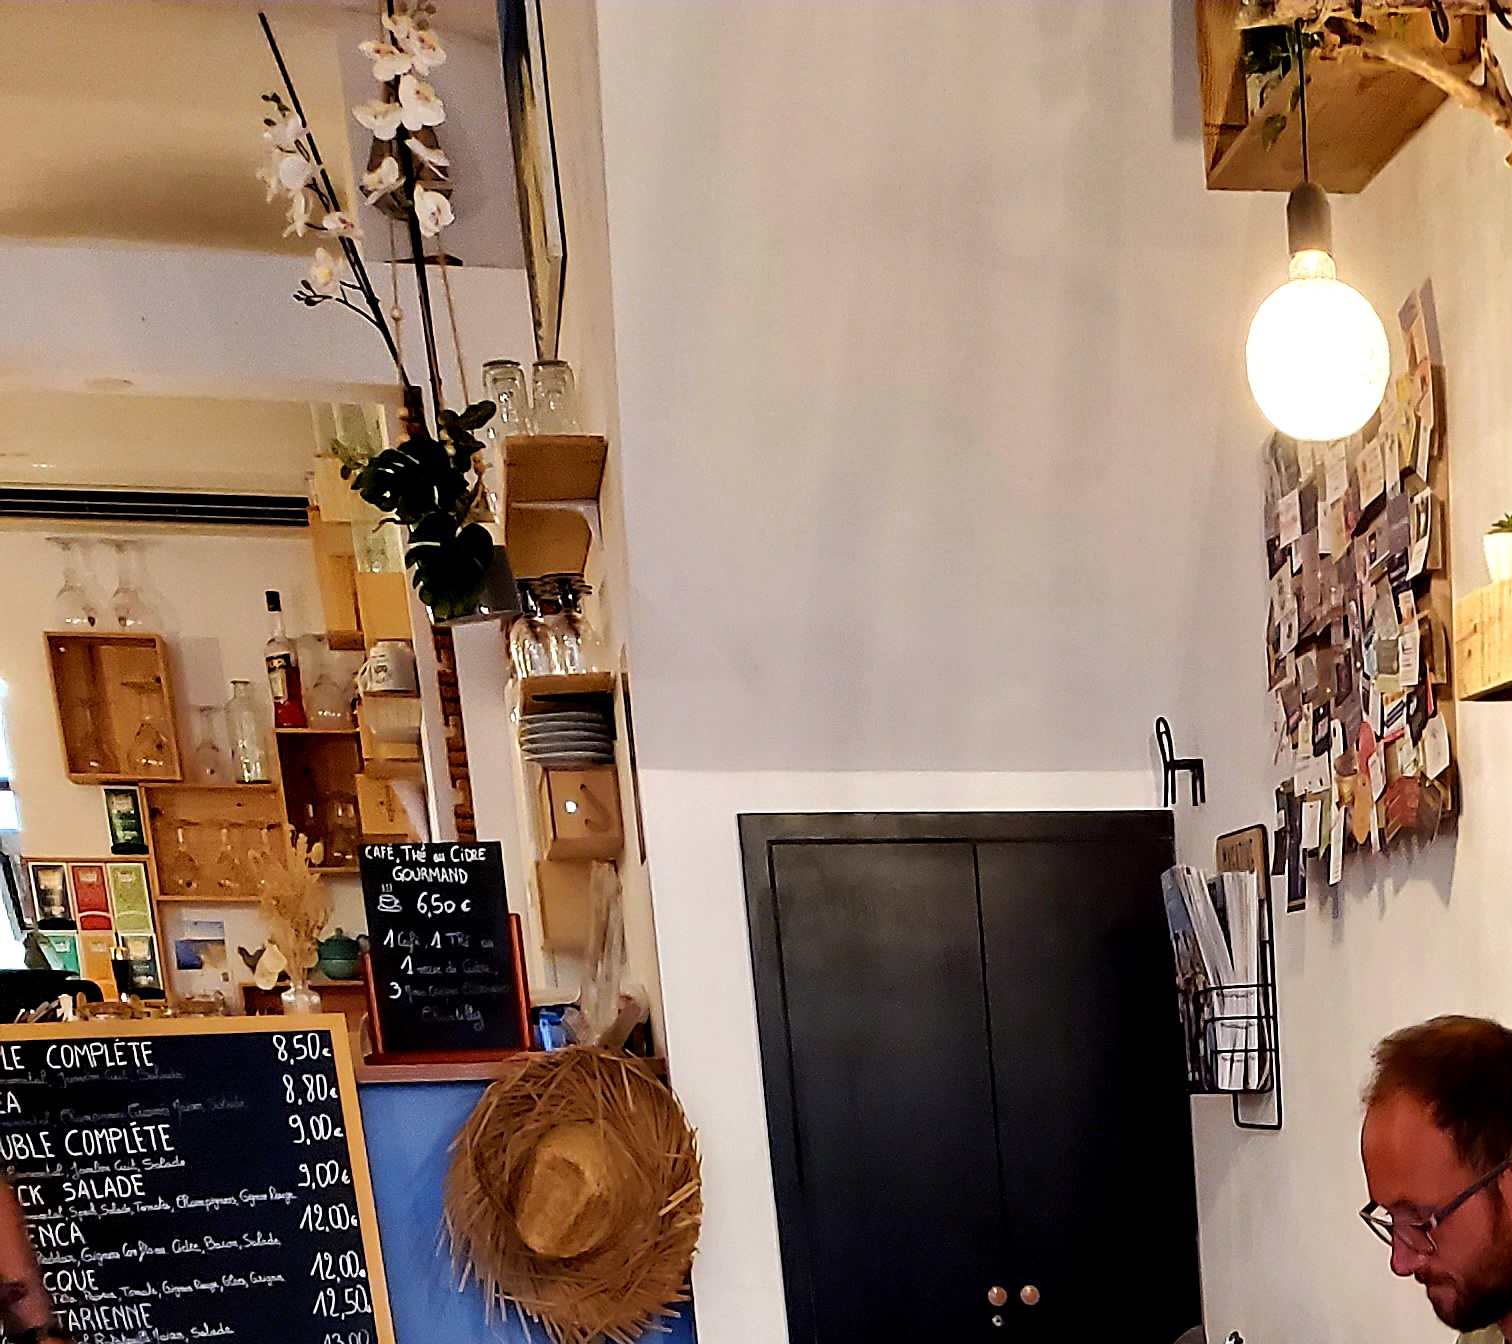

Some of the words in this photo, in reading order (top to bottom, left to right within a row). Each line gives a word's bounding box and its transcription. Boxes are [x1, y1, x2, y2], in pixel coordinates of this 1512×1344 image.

[392, 865, 468, 884] GOURMAND
[388, 981, 402, 1000] 3
[62, 1174, 146, 1202] SALADE
